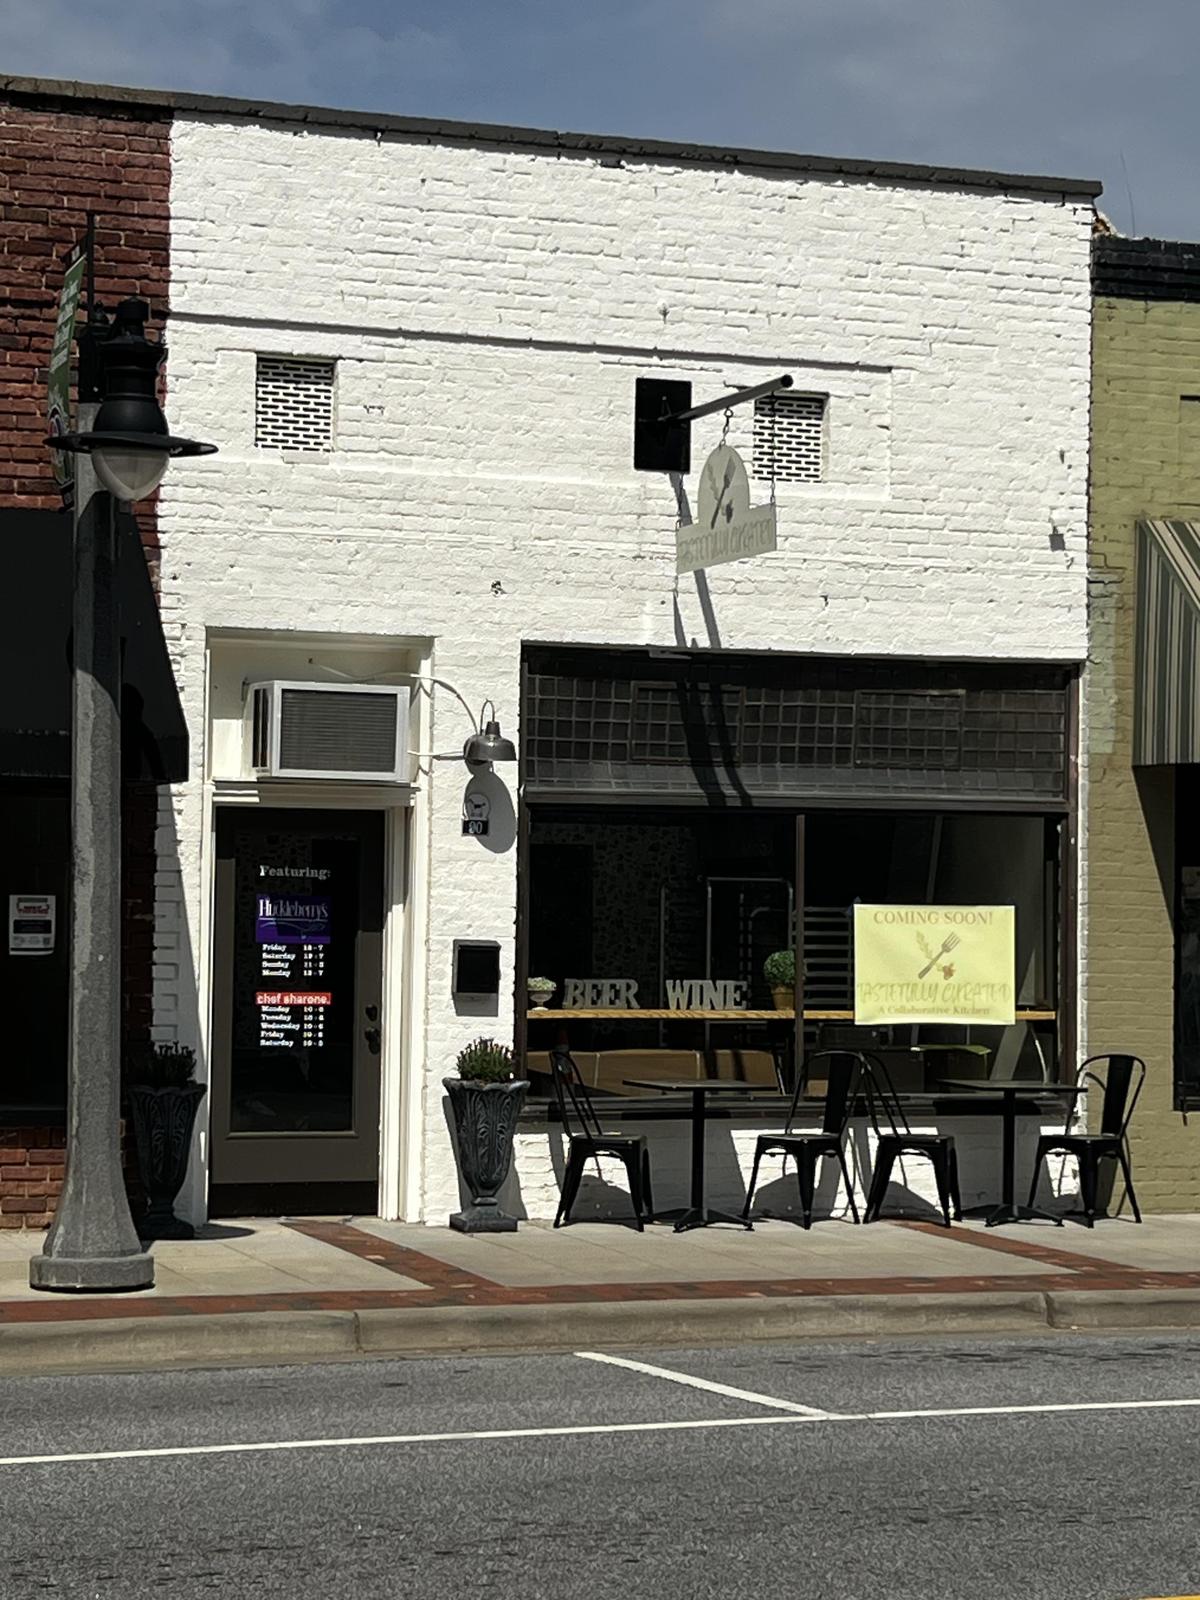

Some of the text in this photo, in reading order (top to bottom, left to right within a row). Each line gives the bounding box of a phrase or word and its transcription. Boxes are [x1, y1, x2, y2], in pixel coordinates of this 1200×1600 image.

[260, 864, 331, 880] Featuring:
[873, 910, 993, 925] COMING SOON!
[262, 944, 287, 952] Friday
[257, 993, 281, 1004] chef
[562, 978, 748, 1011] BEER WINE
[942, 982, 1011, 1003] CURATED
[878, 1006, 990, 1015] A Collaborative Kitchen
[260, 1031, 285, 1039] Friday
